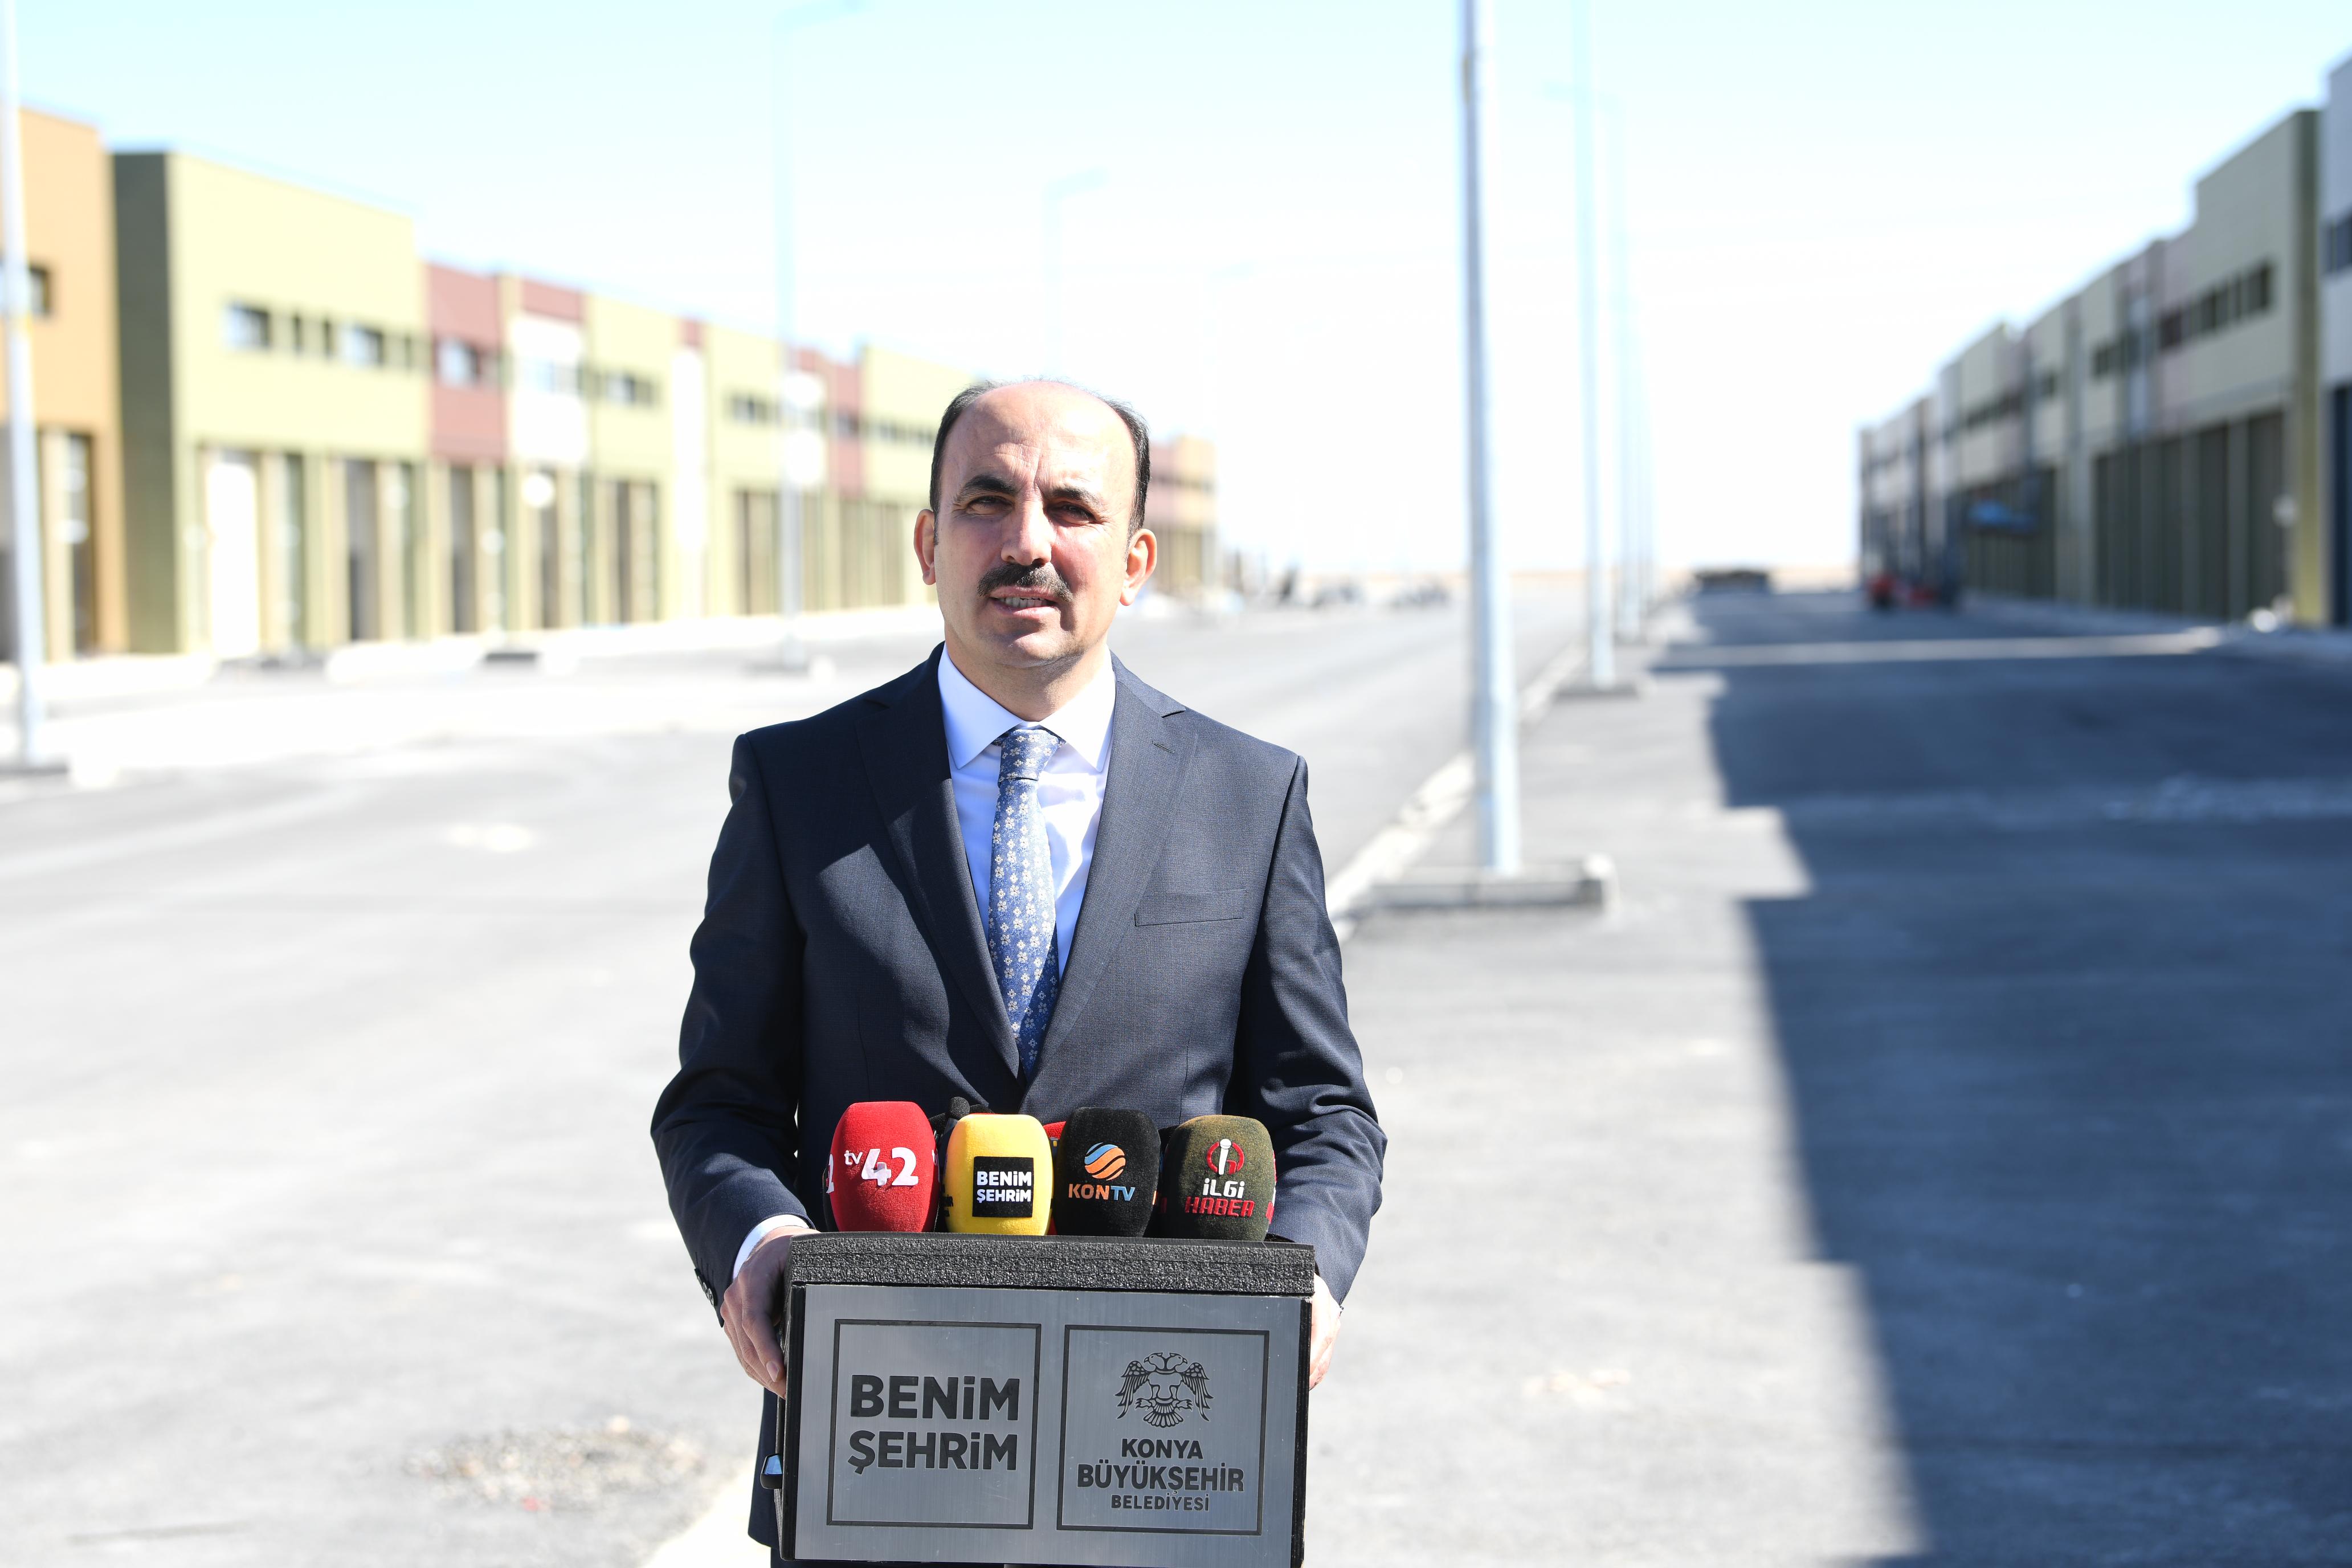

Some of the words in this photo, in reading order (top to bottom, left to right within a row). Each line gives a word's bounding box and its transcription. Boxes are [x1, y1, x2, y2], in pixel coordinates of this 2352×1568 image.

[1068, 1183, 1136, 1201] KONTV
[1185, 1196, 1255, 1217] HABER
[1121, 1438, 1203, 1459] KONYA
[1077, 1459, 1244, 1494] BÜYÜKŞEHİR
[1111, 1492, 1209, 1511] BELEDİYESİ
